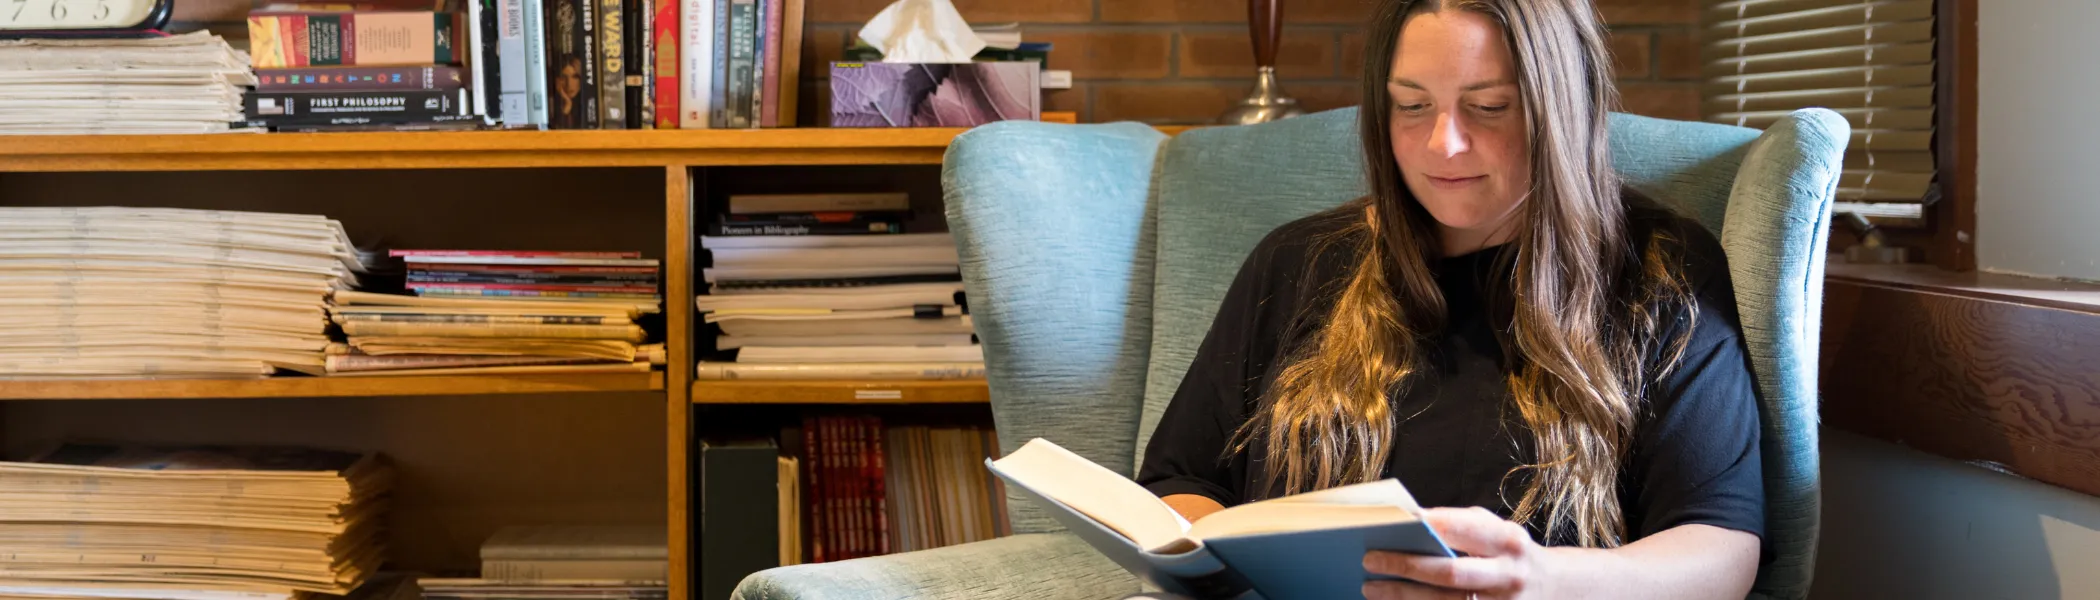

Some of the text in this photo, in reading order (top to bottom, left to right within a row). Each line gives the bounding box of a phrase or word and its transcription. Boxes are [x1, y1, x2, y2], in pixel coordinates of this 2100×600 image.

[11, 0, 27, 22] 7
[50, 0, 67, 21] 6
[689, 1, 700, 46] digital
[742, 6, 751, 53] WILLIAM
[604, 10, 622, 72] WARD
[733, 17, 743, 57] GIBSON
[261, 73, 402, 85] GENERATION
[585, 35, 593, 85] SOCIETY
[310, 96, 406, 107] FIRST PHILOSOPHY
[721, 224, 810, 236] Pioneers in Bibliography
